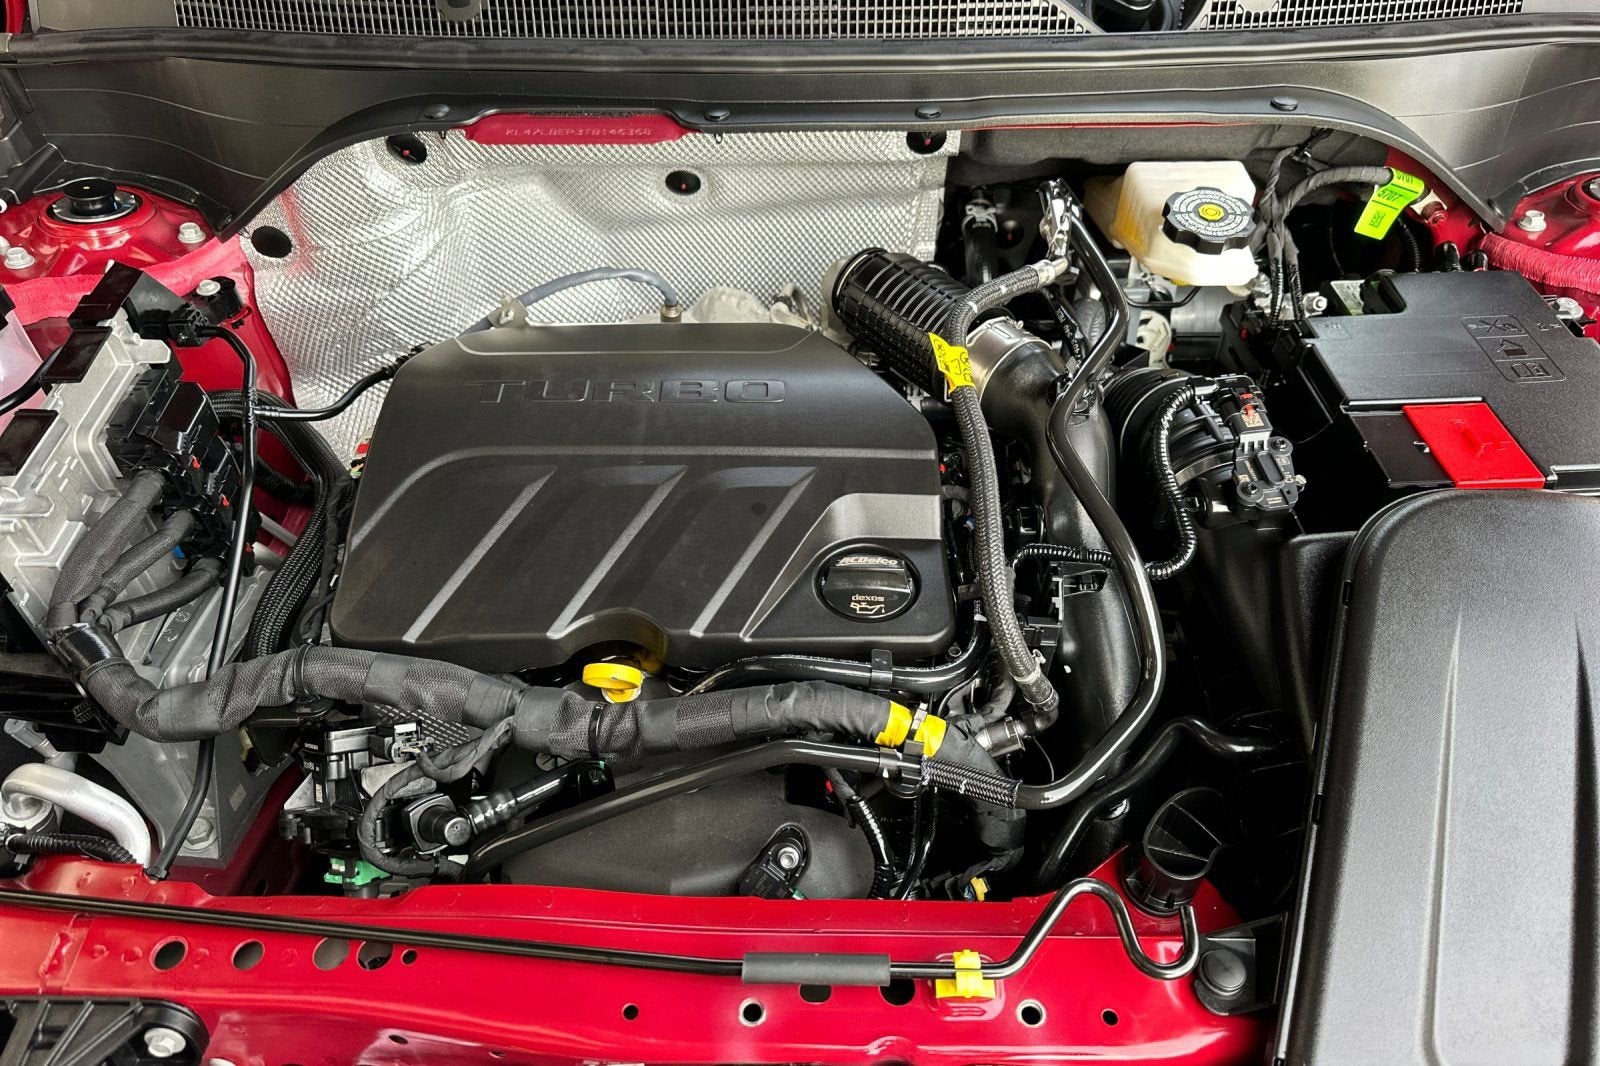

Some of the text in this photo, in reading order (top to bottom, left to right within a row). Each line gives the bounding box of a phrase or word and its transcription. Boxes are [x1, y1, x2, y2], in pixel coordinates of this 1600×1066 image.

[1377, 188, 1402, 202] 5707
[464, 379, 786, 404] TURBO
[836, 556, 898, 566] ACDelco
[851, 593, 886, 602] dexos
